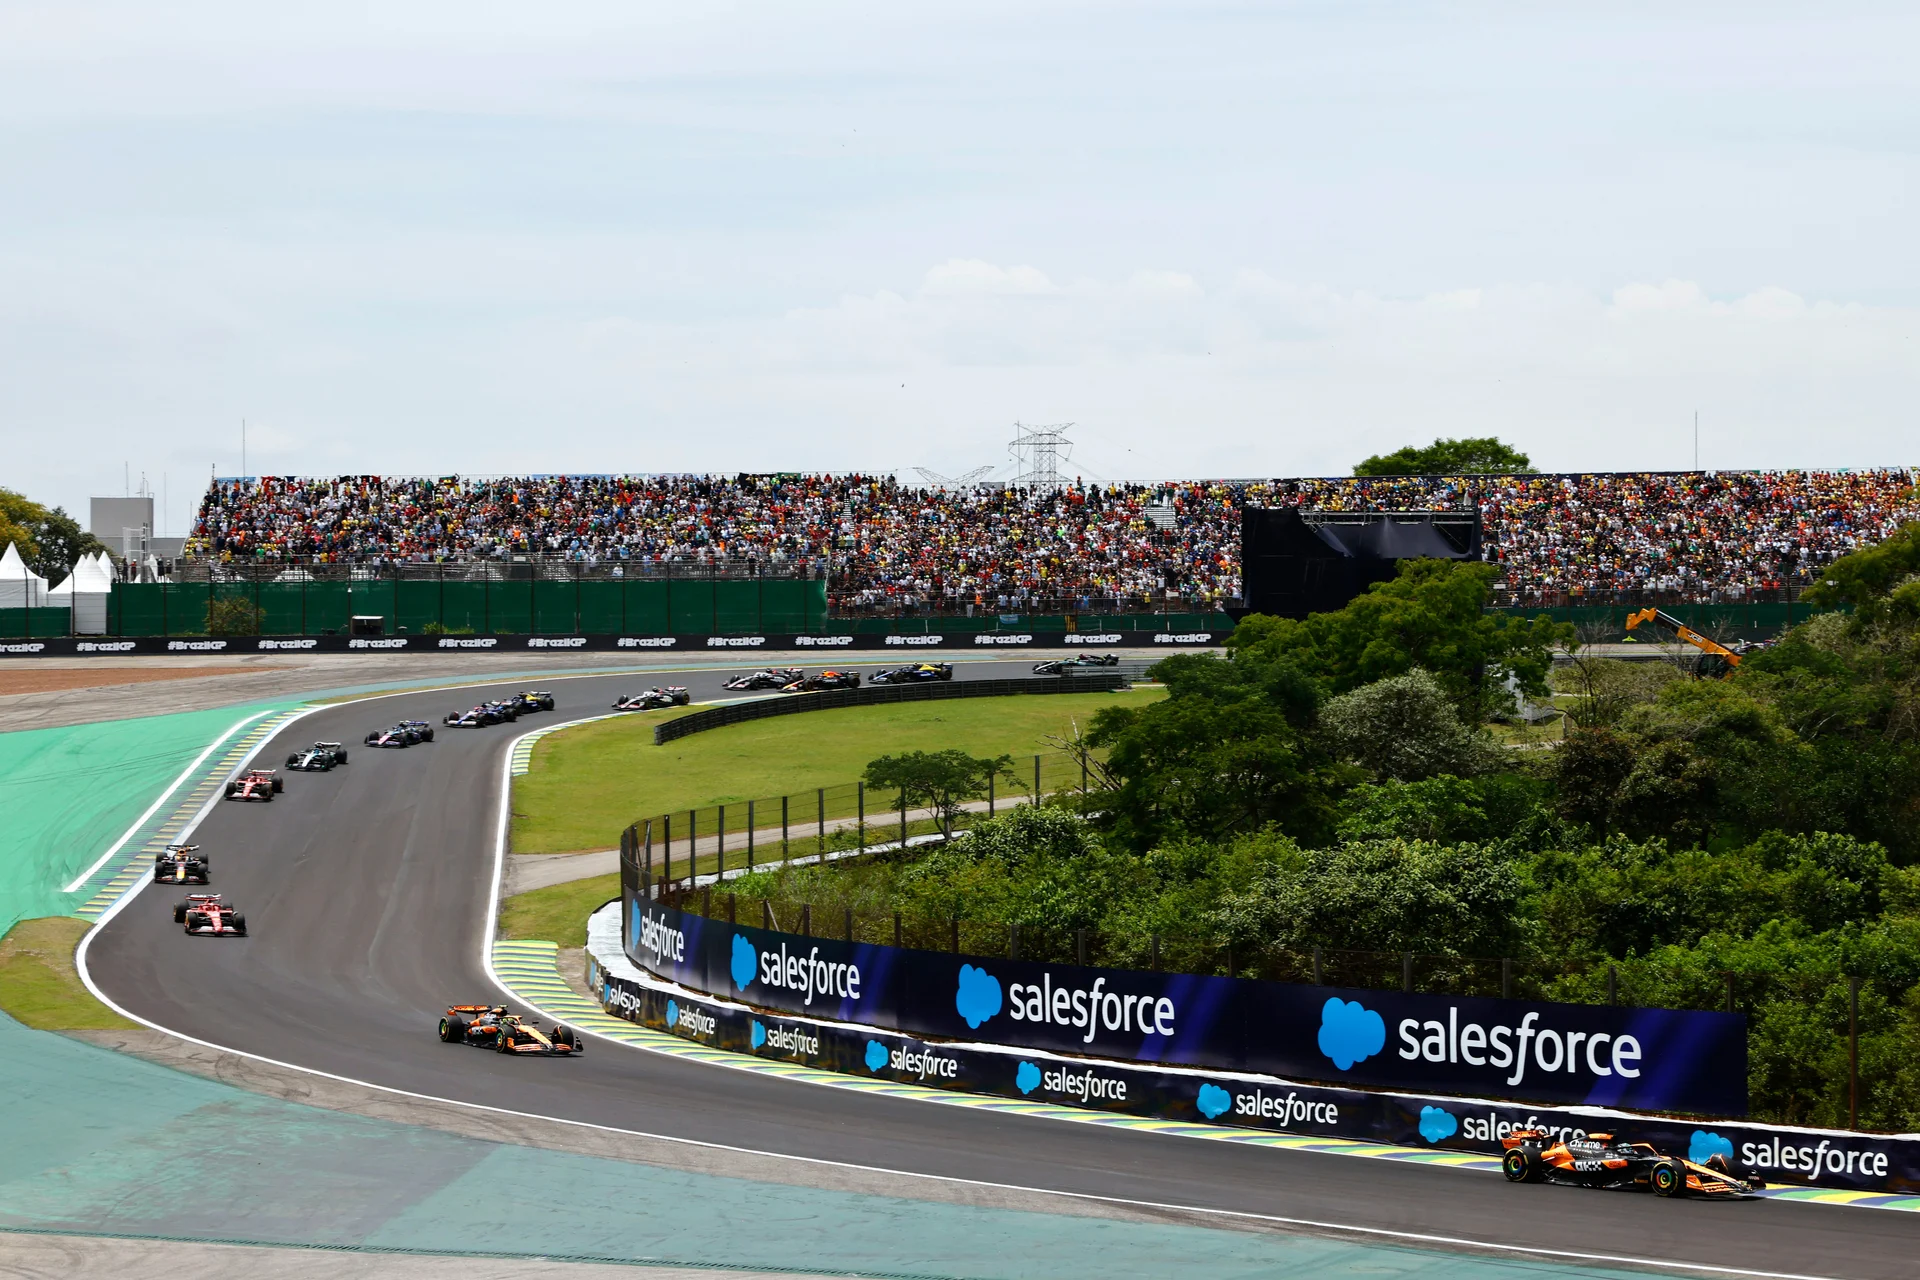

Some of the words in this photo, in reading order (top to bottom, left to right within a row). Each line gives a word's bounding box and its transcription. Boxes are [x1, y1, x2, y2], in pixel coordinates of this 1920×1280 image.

[349, 638, 408, 649] #BrazilGP
[439, 638, 498, 649] #BrazilGP
[528, 637, 587, 648] #BrazilGP
[618, 637, 677, 648] #BrazilGP
[707, 636, 766, 647] #BrazilGP
[796, 636, 854, 647] #BrazilGP
[885, 635, 944, 646] #BrazilGP
[975, 634, 1033, 645] #BrazilGP
[1065, 634, 1123, 645] #BrazilGP
[1154, 633, 1212, 644] #BrazilGP
[0, 643, 45, 653] razilGP
[77, 641, 136, 652] #BrazilGP
[168, 640, 227, 651] #BrazilGP
[258, 639, 318, 650] #BrazilGP
[640, 907, 685, 966] salesforce
[760, 942, 861, 1006] salesforce
[1009, 973, 1175, 1044] salesforce
[678, 1005, 716, 1037] salesforce
[767, 1024, 819, 1057] salesforce
[1399, 1006, 1642, 1086] salesforce
[890, 1045, 958, 1081] salesforce
[1043, 1067, 1127, 1103] salesforce
[1235, 1088, 1339, 1128] salesforce
[1741, 1136, 1889, 1180] salesforce
